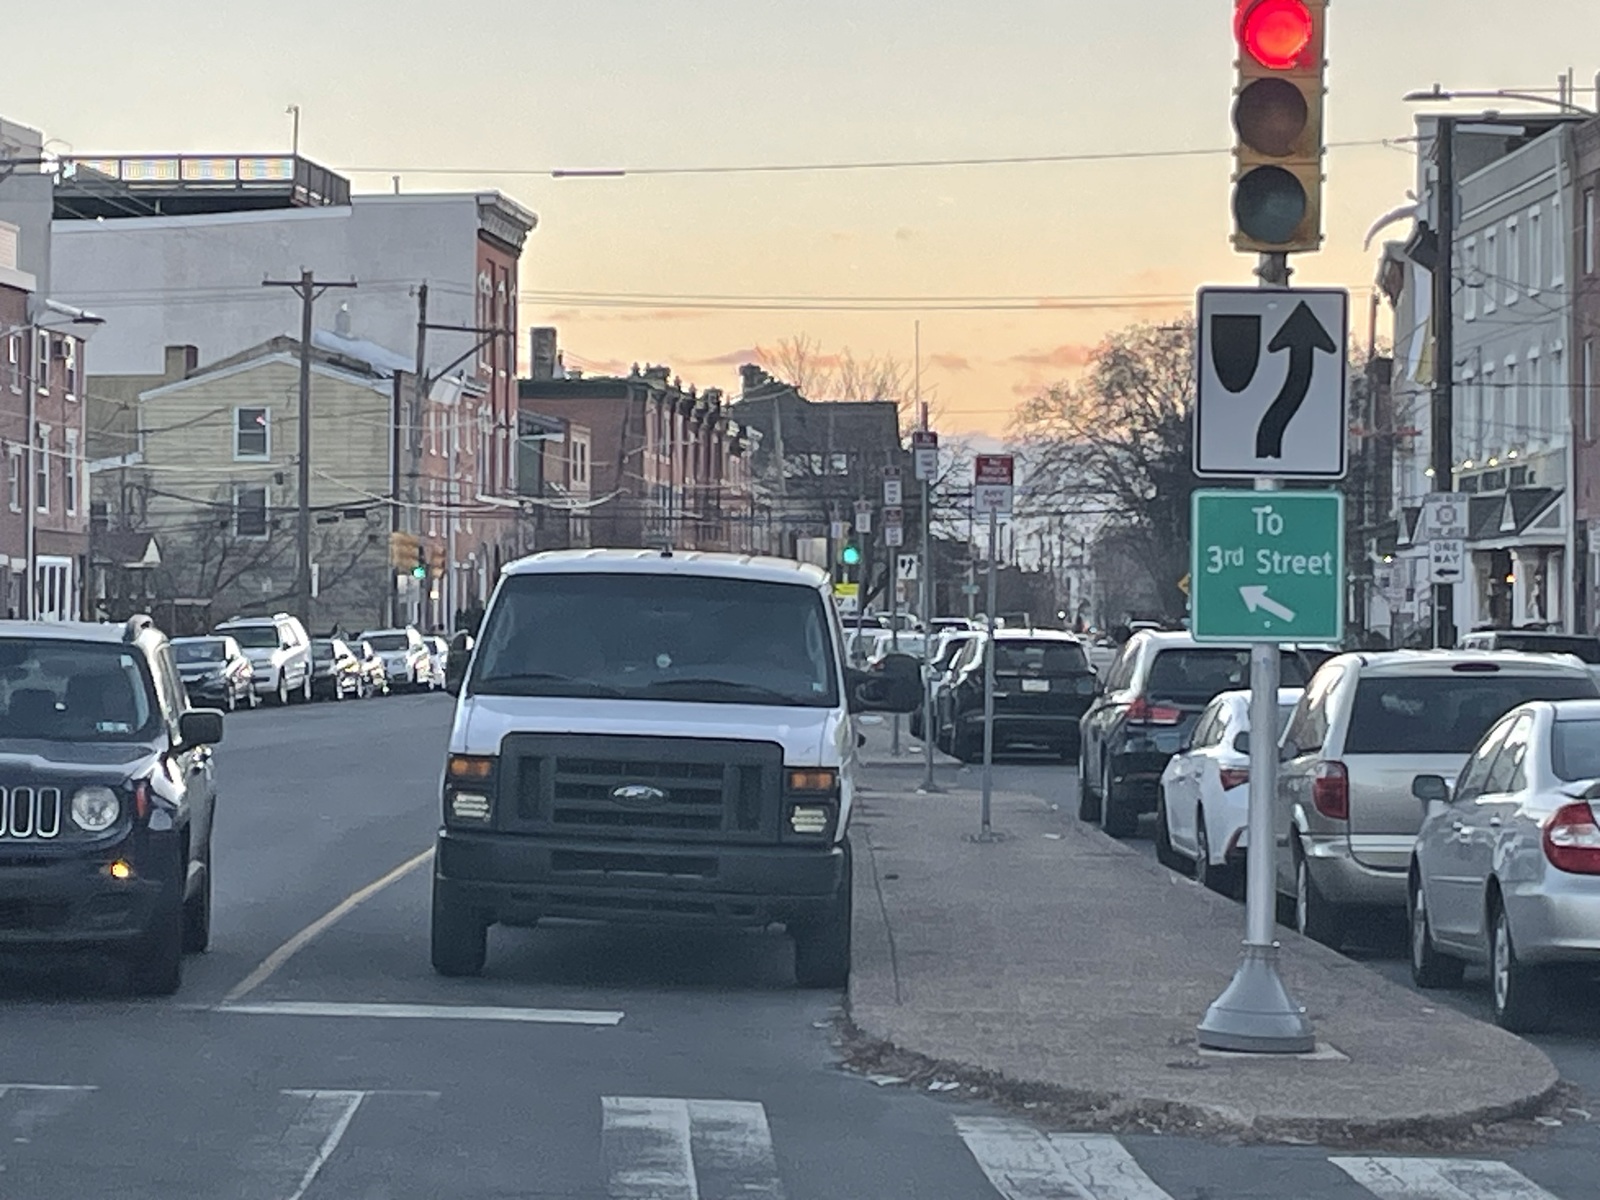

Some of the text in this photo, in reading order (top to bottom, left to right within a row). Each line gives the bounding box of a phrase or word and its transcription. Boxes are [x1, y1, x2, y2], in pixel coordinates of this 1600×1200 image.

[1251, 505, 1284, 536] To
[1434, 541, 1459, 552] ONE
[1206, 545, 1333, 576] 3rd Street
[1434, 554, 1460, 563] WAY
